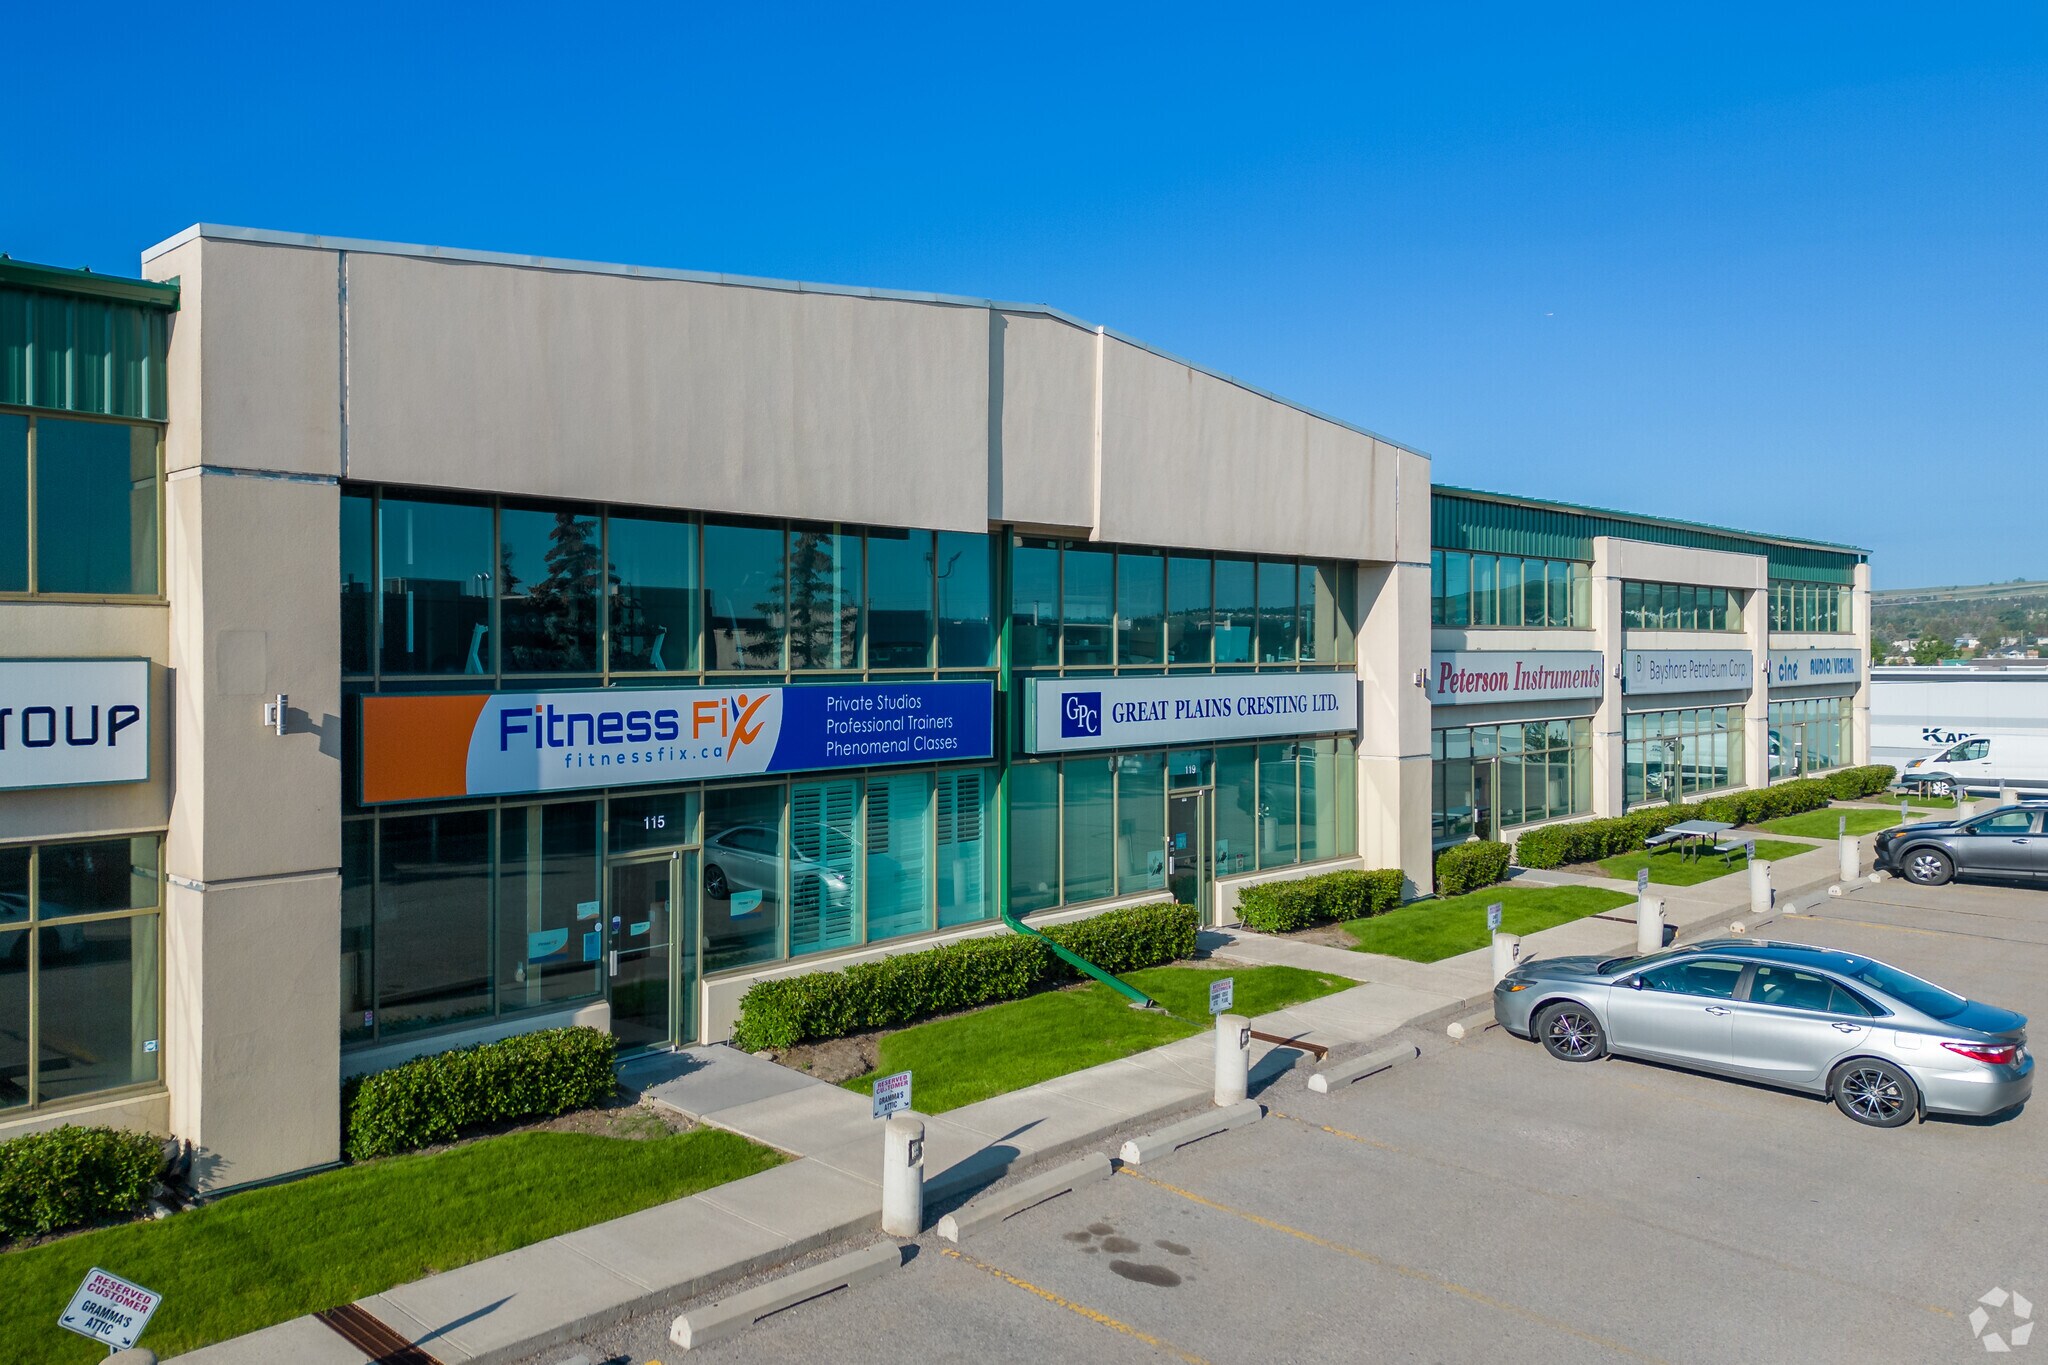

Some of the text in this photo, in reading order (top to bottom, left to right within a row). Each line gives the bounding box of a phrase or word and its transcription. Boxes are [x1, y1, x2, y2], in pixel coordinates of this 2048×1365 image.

[1437, 661, 1600, 694] Peterson Instruments
[1649, 658, 1748, 685] Bayshore Petroleum Corp.
[826, 694, 922, 712] Private Studios
[1112, 693, 1339, 724] GREAT PLAINS CRESTING LTD.
[826, 714, 953, 735] Professional Trainers
[1066, 696, 1098, 734] GPC
[500, 693, 772, 764] Fitness Fix
[564, 746, 722, 769] fitnessfix.ca
[826, 735, 958, 757] Phenomenal Classes
[1185, 764, 1197, 774] 119
[643, 815, 665, 830] 115
[877, 1074, 908, 1089] RESERVED
[884, 1100, 898, 1111] ATTIC
[86, 1283, 149, 1314] CUSTOMER
[94, 1274, 153, 1305] RESERVED
[81, 1300, 133, 1328] GRAMMA'S
[84, 1317, 114, 1336] ATTIC
